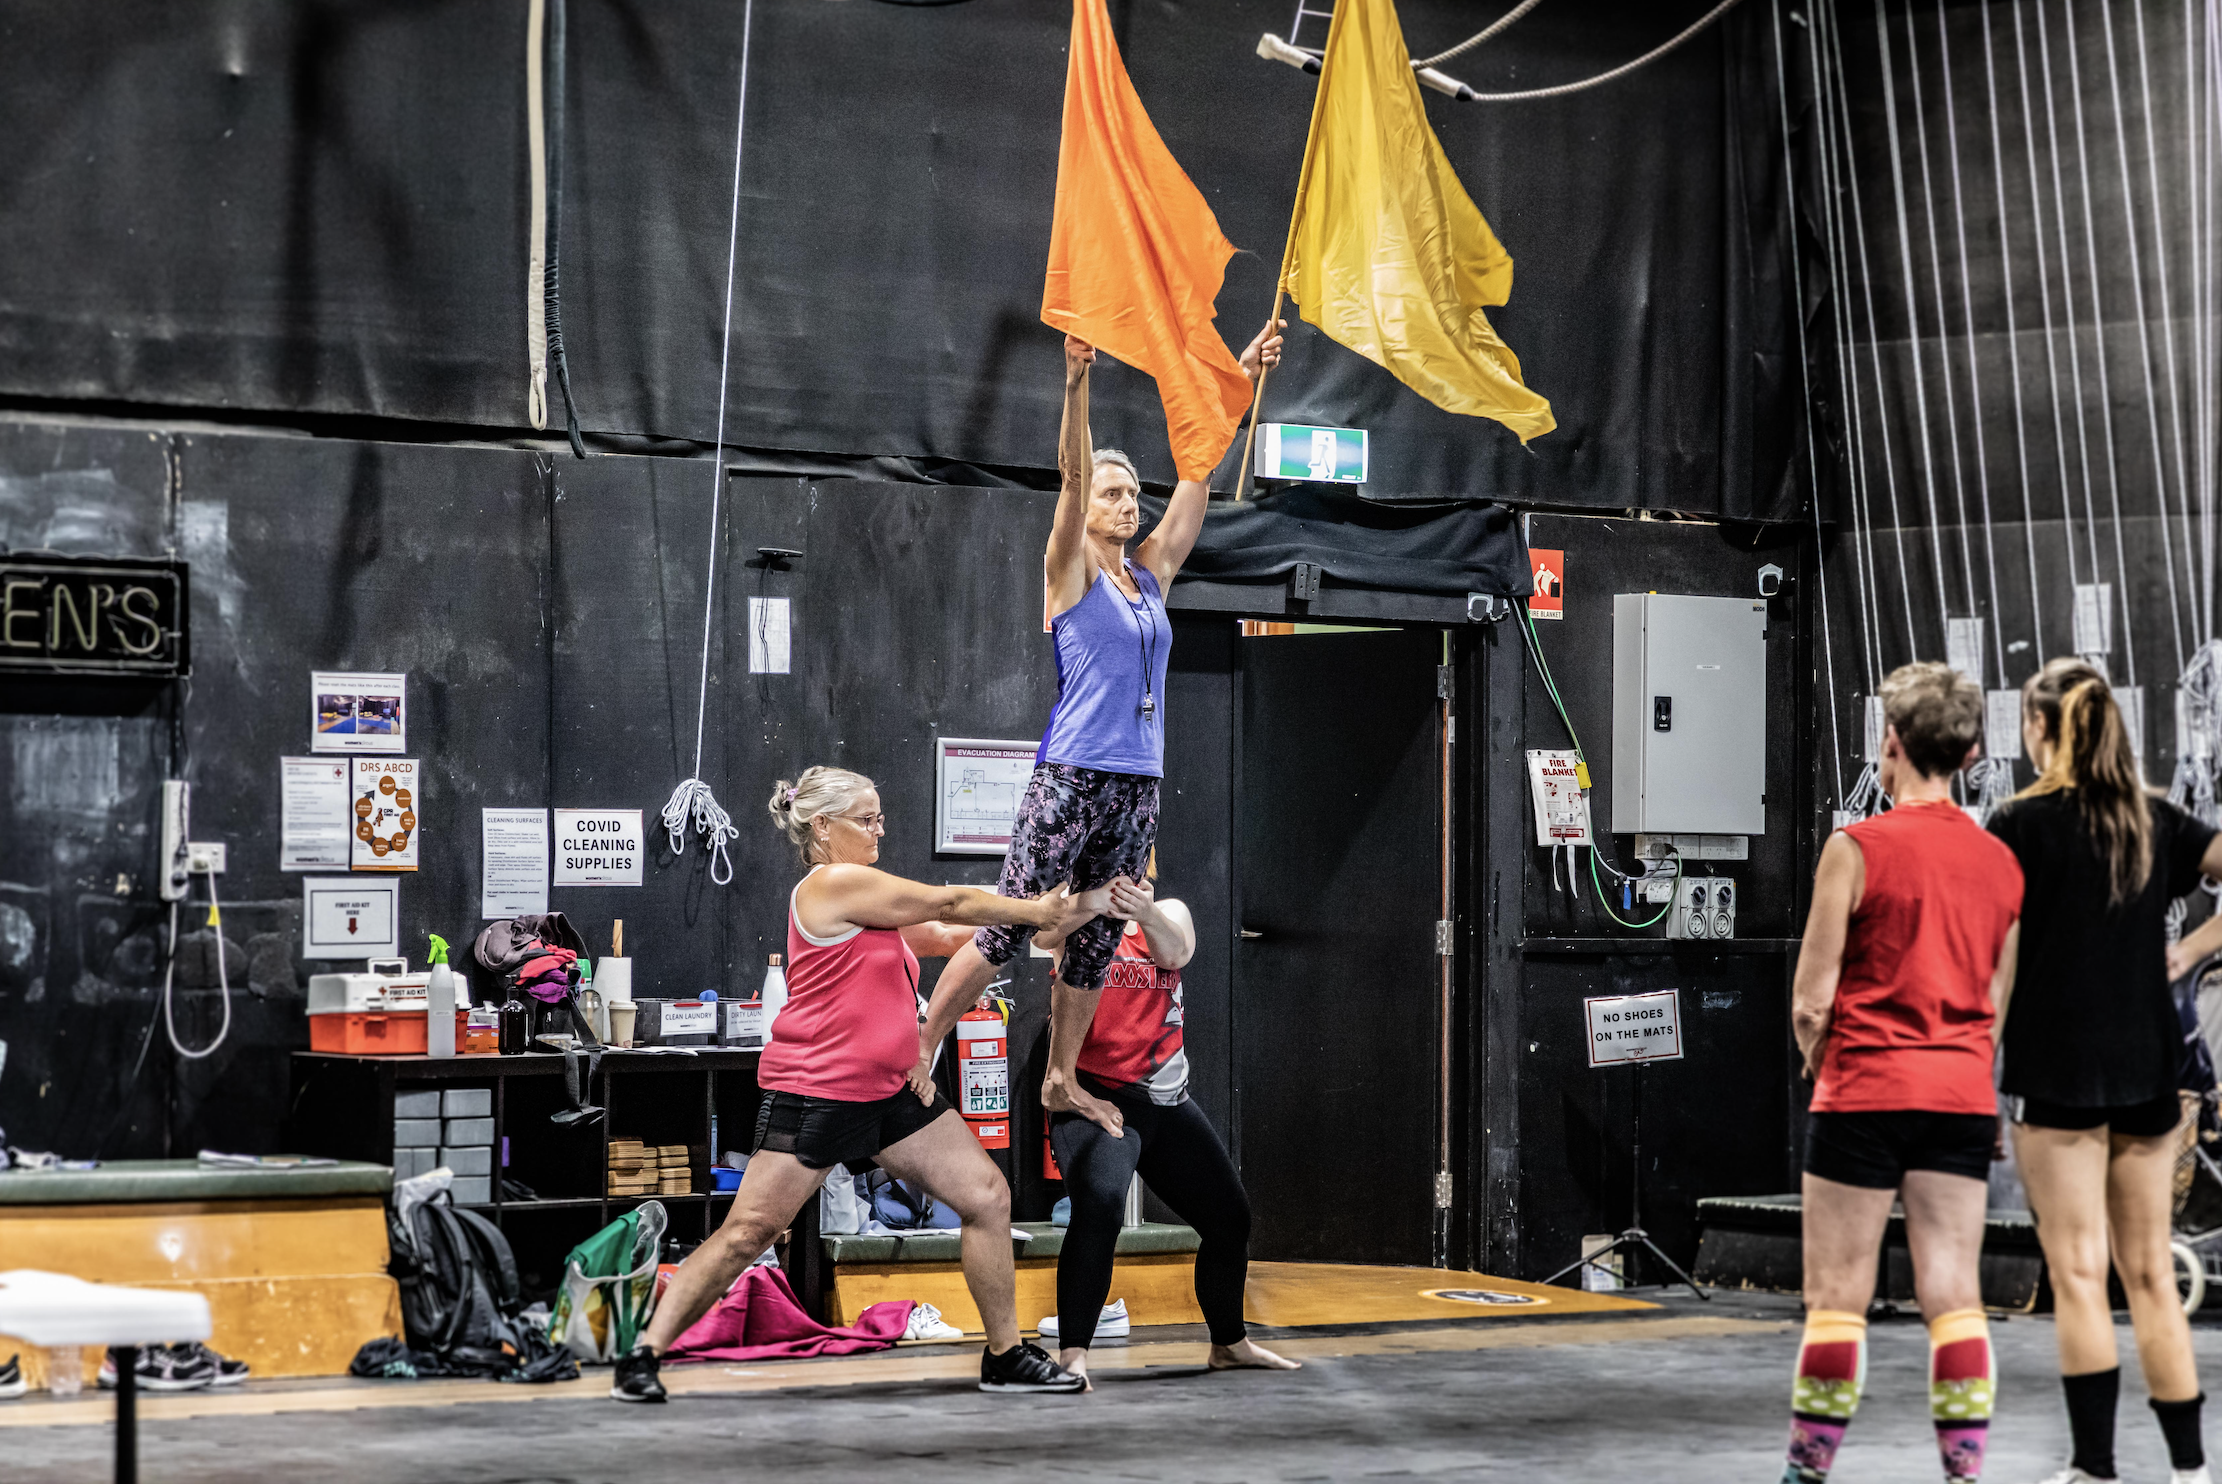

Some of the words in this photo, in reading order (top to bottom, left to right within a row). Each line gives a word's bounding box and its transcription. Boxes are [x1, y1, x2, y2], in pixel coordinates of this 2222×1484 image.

[5, 581, 160, 654] EN'S
[1540, 611, 1562, 619] BLANKET
[958, 749, 1002, 758] EVACUATION
[1003, 750, 1034, 758] DIAGRAM
[360, 762, 380, 772] DRS
[384, 763, 412, 773] ABCD
[1549, 760, 1567, 768] FIRE
[576, 820, 621, 832] COVID
[563, 839, 635, 851] CLEANING
[566, 858, 632, 870] SUPPLIES
[665, 1012, 684, 1020] CLEAN
[684, 1012, 712, 1020] LAUNDRY
[1604, 1013, 1620, 1022] NO
[1624, 1008, 1664, 1021] SHOES
[1596, 1032, 1612, 1042] ON
[1616, 1030, 1639, 1040] THE
[1644, 1026, 1674, 1037] MATS
